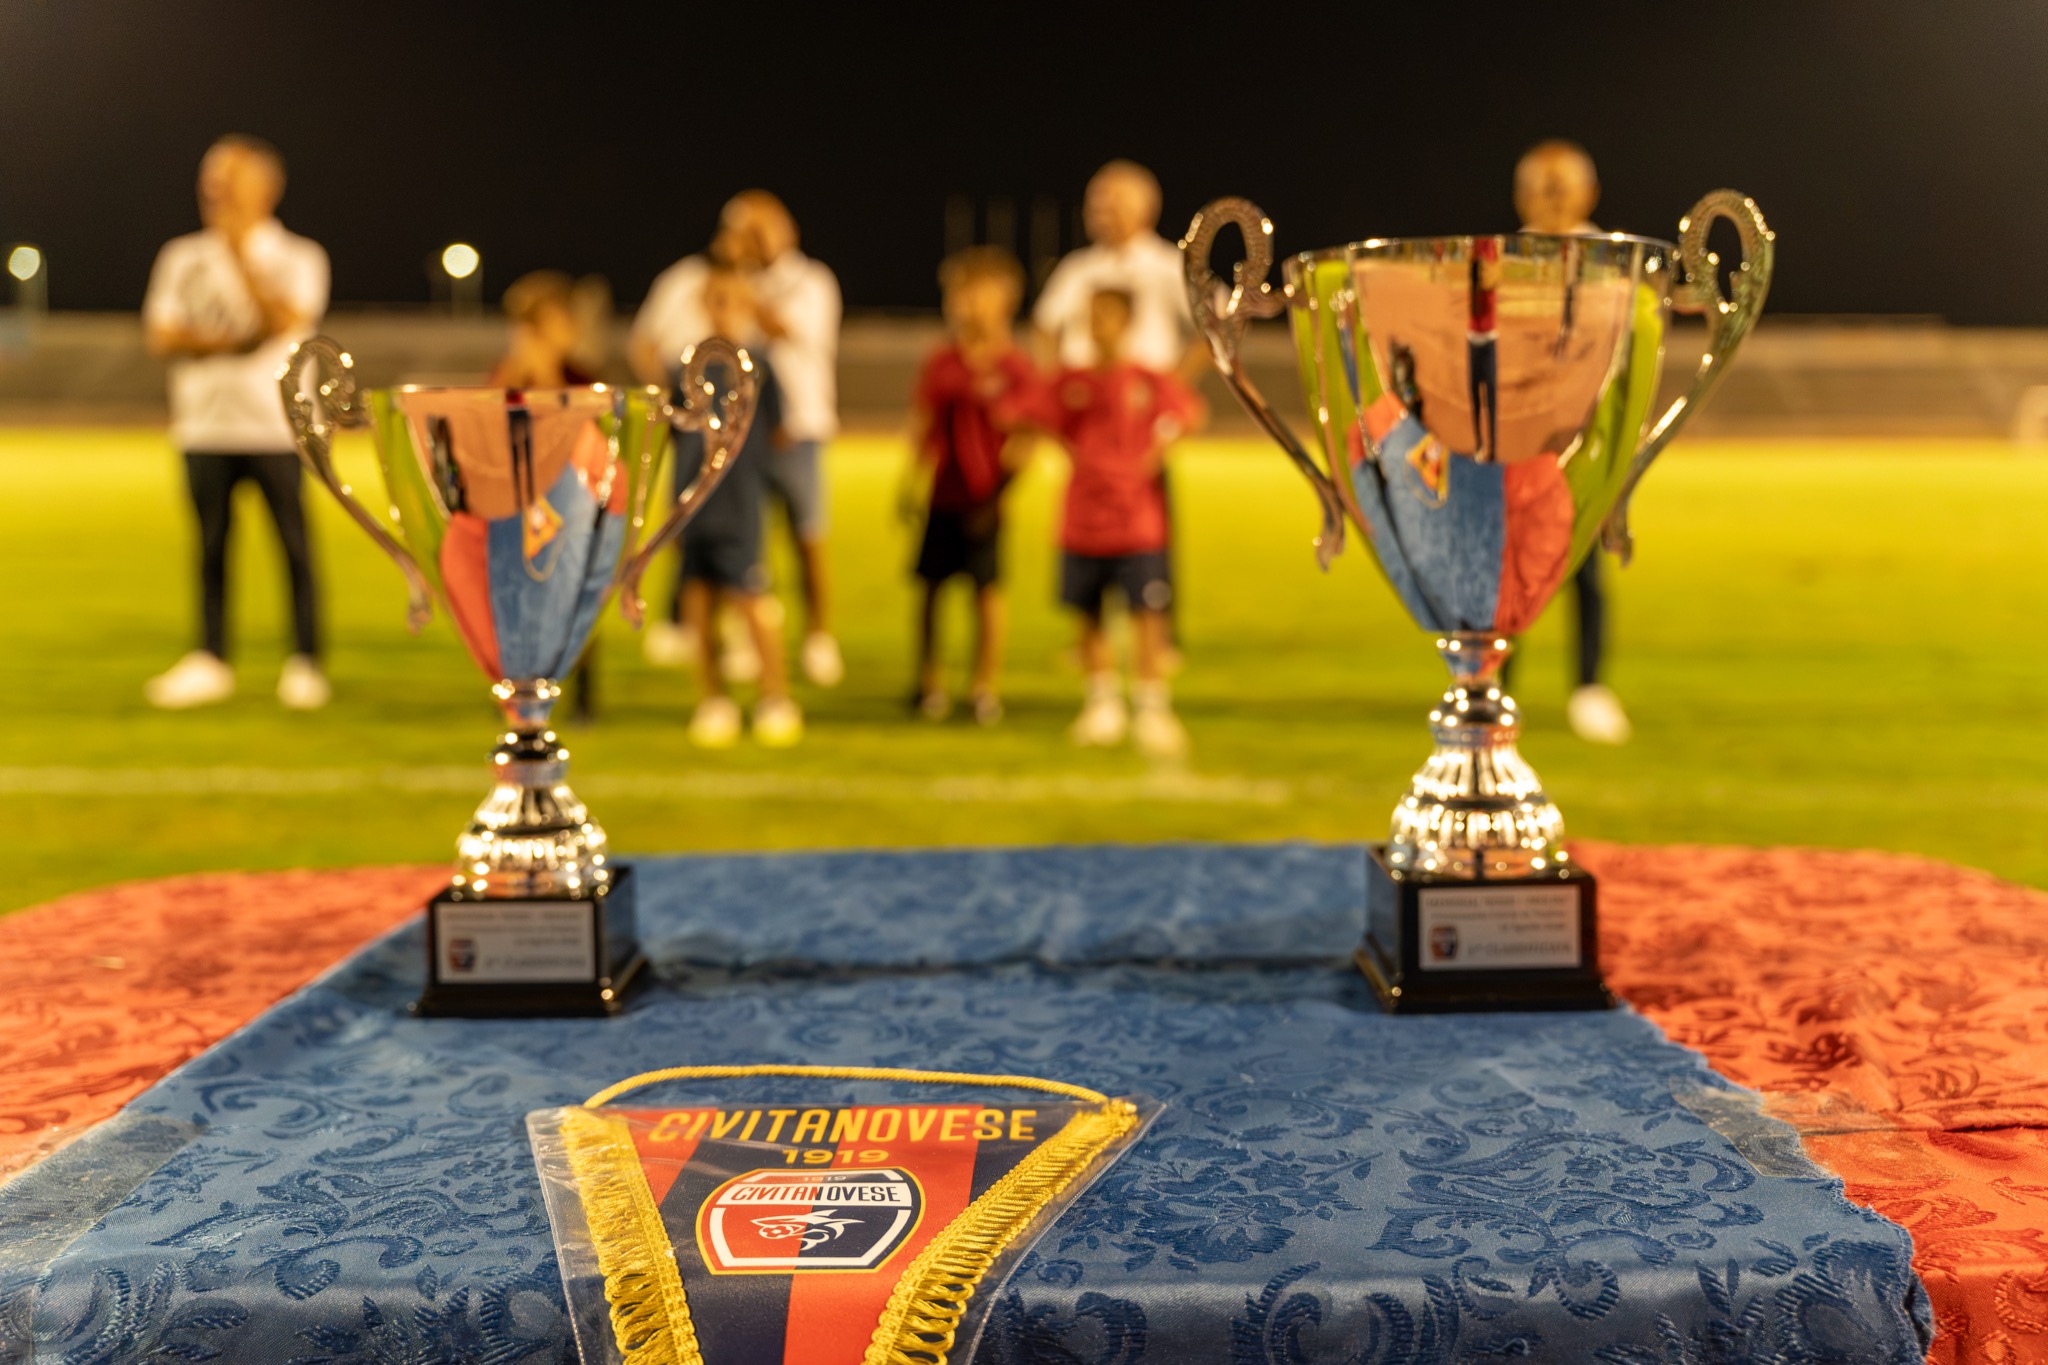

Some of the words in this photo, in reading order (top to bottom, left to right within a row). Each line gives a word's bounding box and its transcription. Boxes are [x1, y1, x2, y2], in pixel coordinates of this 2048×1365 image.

[648, 1108, 1038, 1144] CIVITANOVESE
[781, 1149, 890, 1165] 1919
[730, 1185, 901, 1203] CIVITANOVESE
